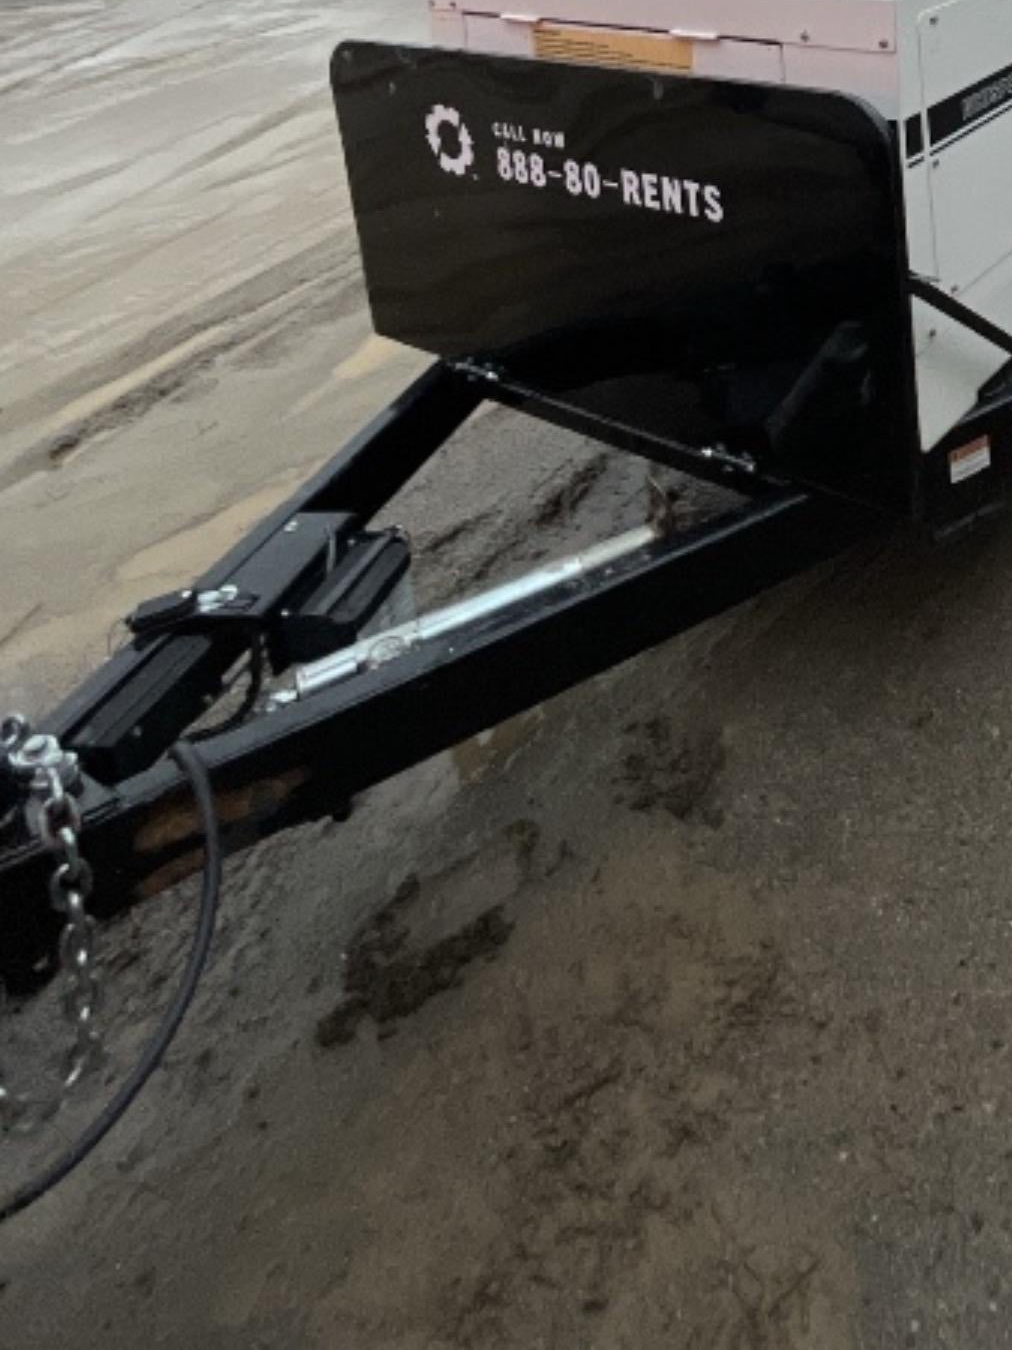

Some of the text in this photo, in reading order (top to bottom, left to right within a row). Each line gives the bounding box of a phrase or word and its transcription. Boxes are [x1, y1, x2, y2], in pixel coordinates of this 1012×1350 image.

[491, 121, 565, 149] CALL NOW
[497, 146, 724, 224] 888-80-RENTS
